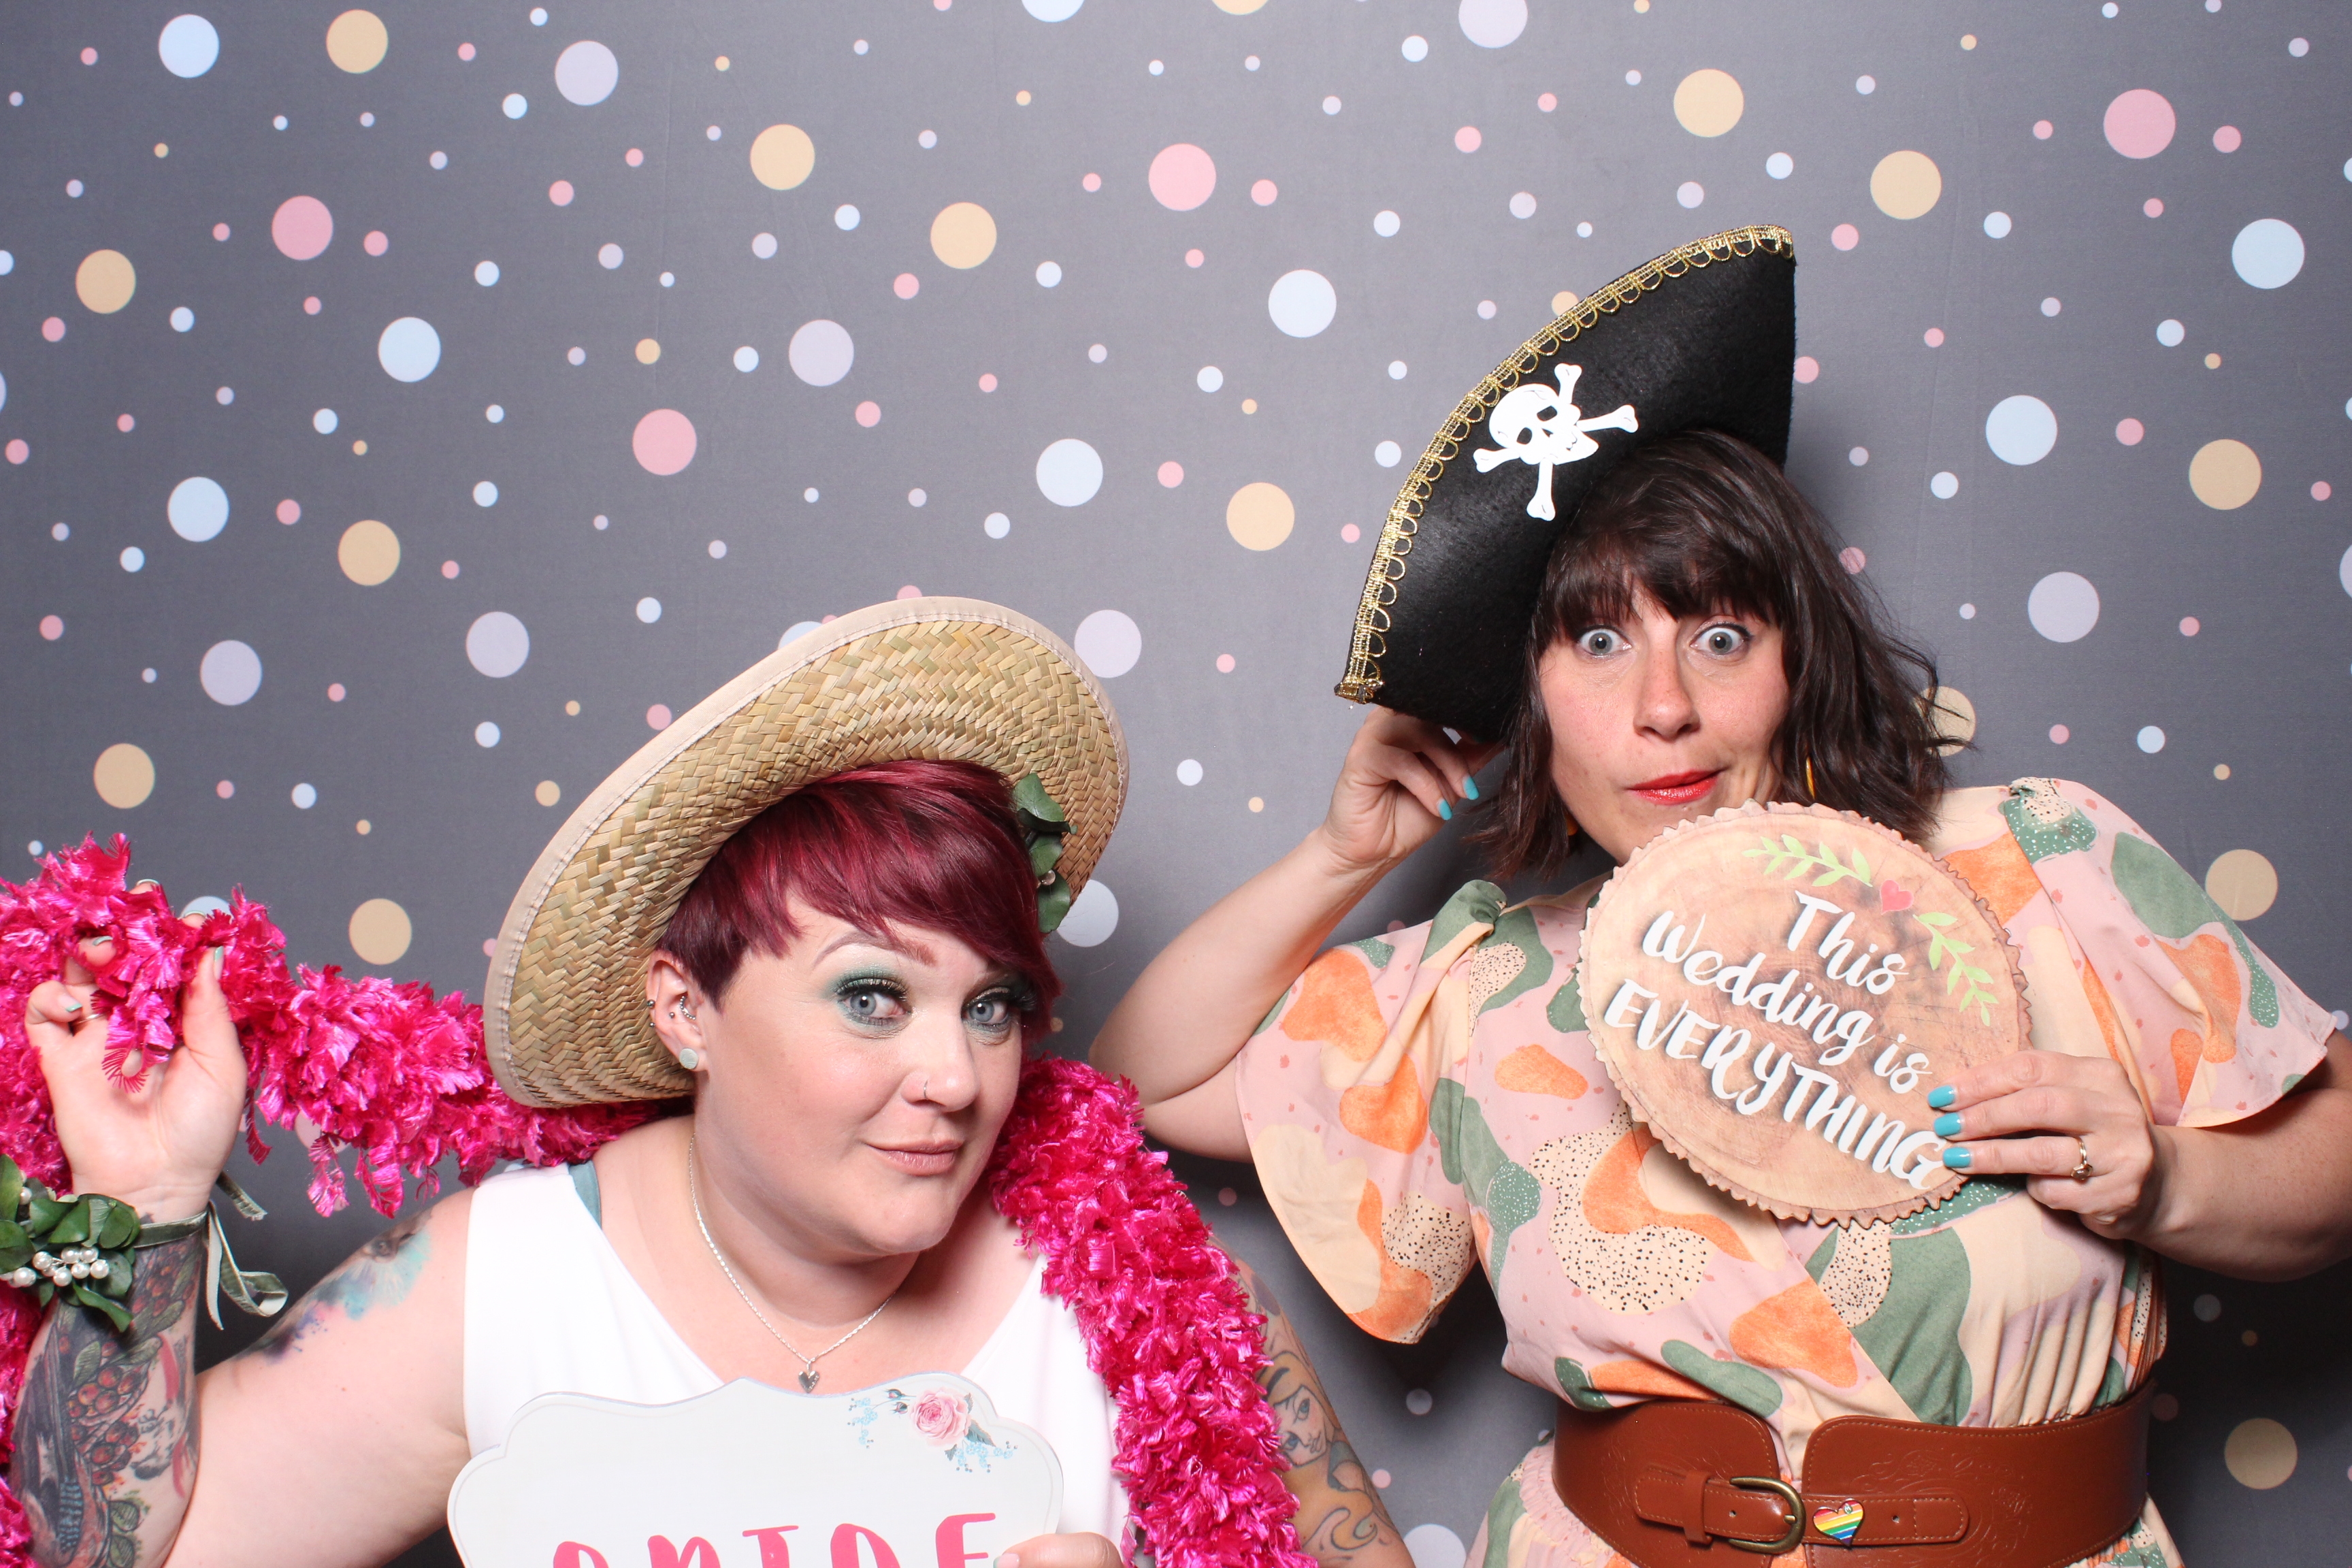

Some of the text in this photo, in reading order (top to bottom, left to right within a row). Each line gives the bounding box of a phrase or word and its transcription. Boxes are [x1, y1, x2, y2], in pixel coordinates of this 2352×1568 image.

[1642, 909, 1932, 1094] Wedding is
[1786, 889, 1909, 995] This
[1603, 977, 1948, 1190] EVERYTHING
